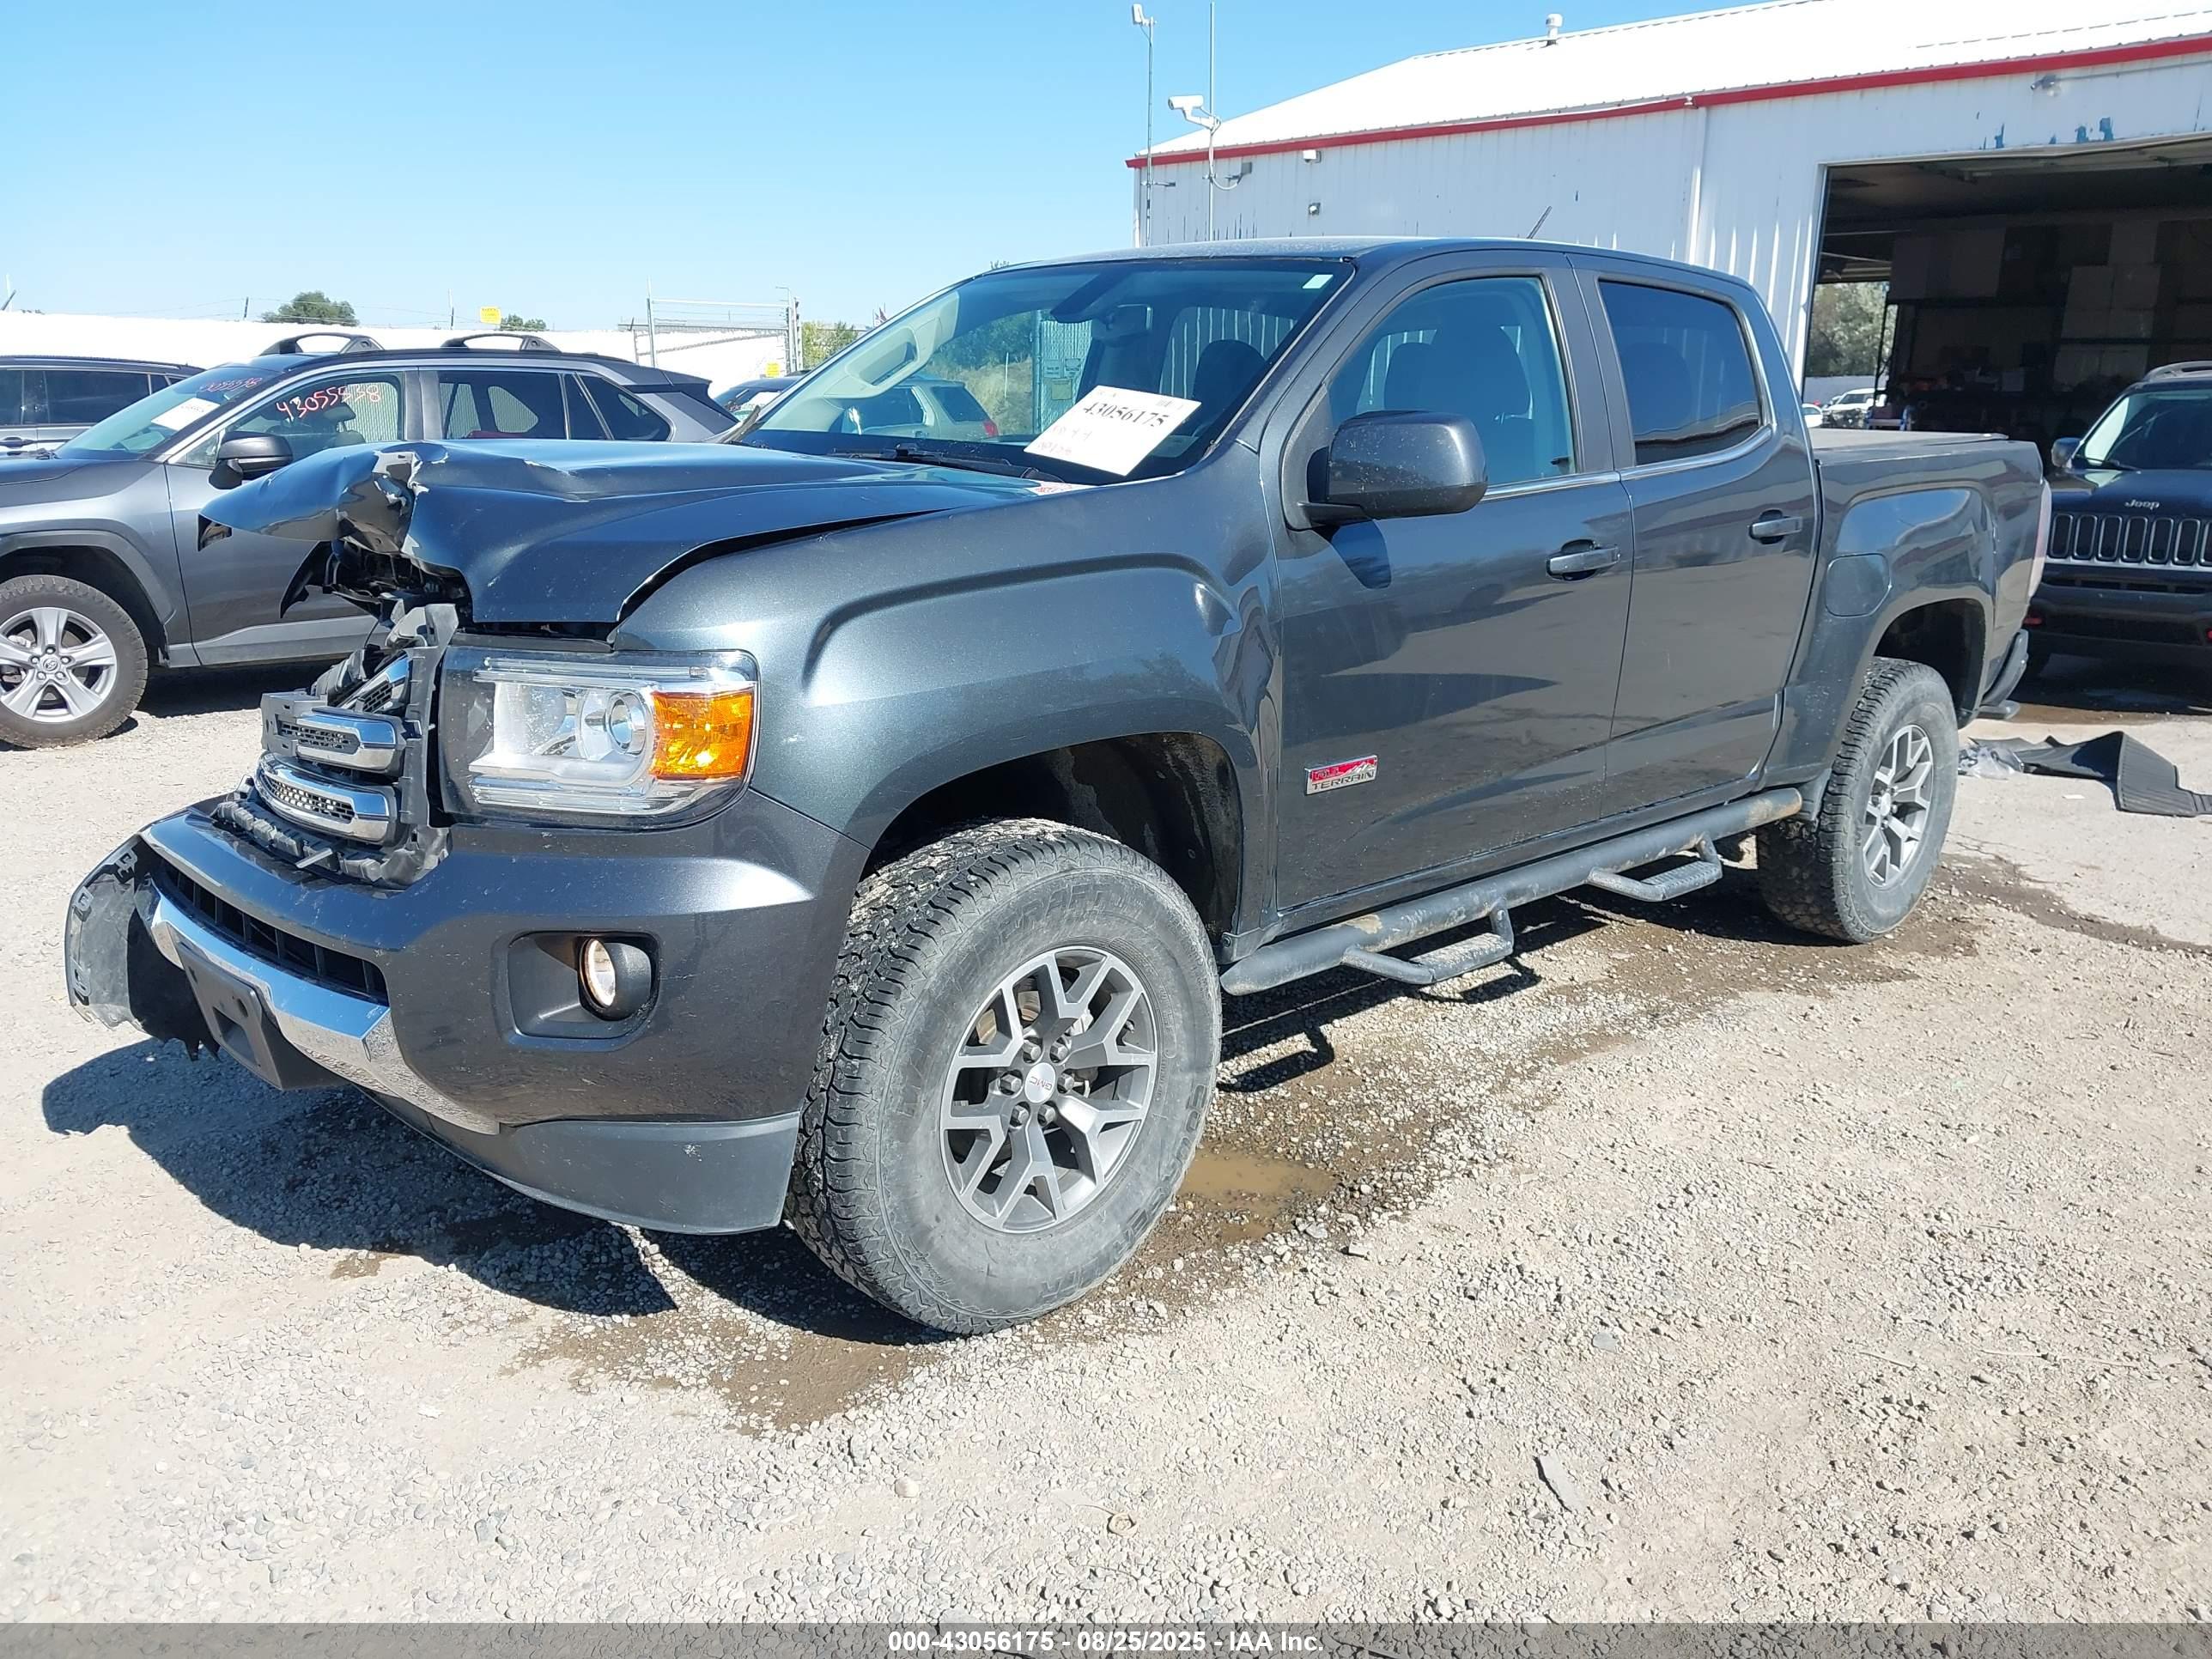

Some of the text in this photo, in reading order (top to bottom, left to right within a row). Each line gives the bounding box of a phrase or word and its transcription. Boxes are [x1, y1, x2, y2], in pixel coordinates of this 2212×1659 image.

[276, 386, 380, 421] 43055538
[1083, 402, 1169, 428] 43056175
[2125, 500, 2160, 510] Jeep
[1312, 772, 1373, 790] TERRAIN
[1030, 1076, 1053, 1091] GMC
